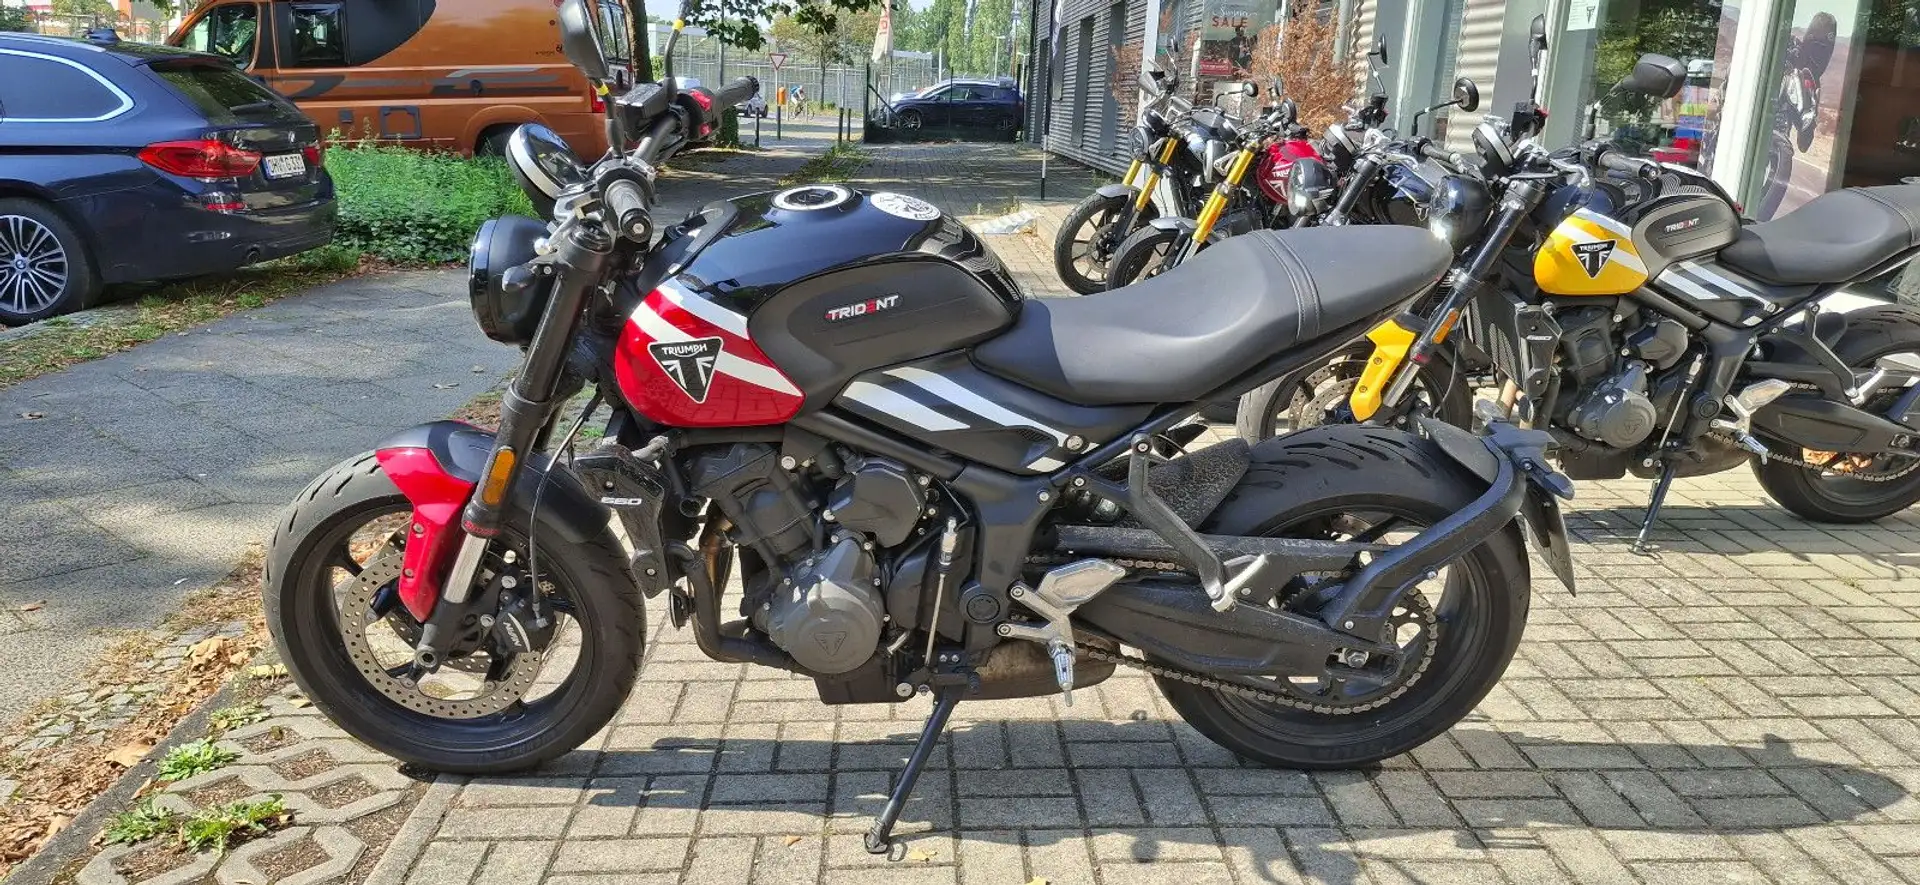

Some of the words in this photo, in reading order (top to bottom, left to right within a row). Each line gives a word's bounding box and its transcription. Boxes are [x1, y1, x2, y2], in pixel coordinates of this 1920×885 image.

[1211, 16, 1248, 28] SALE
[827, 295, 899, 321] TRIDENT
[661, 343, 708, 356] TRIUMPH
